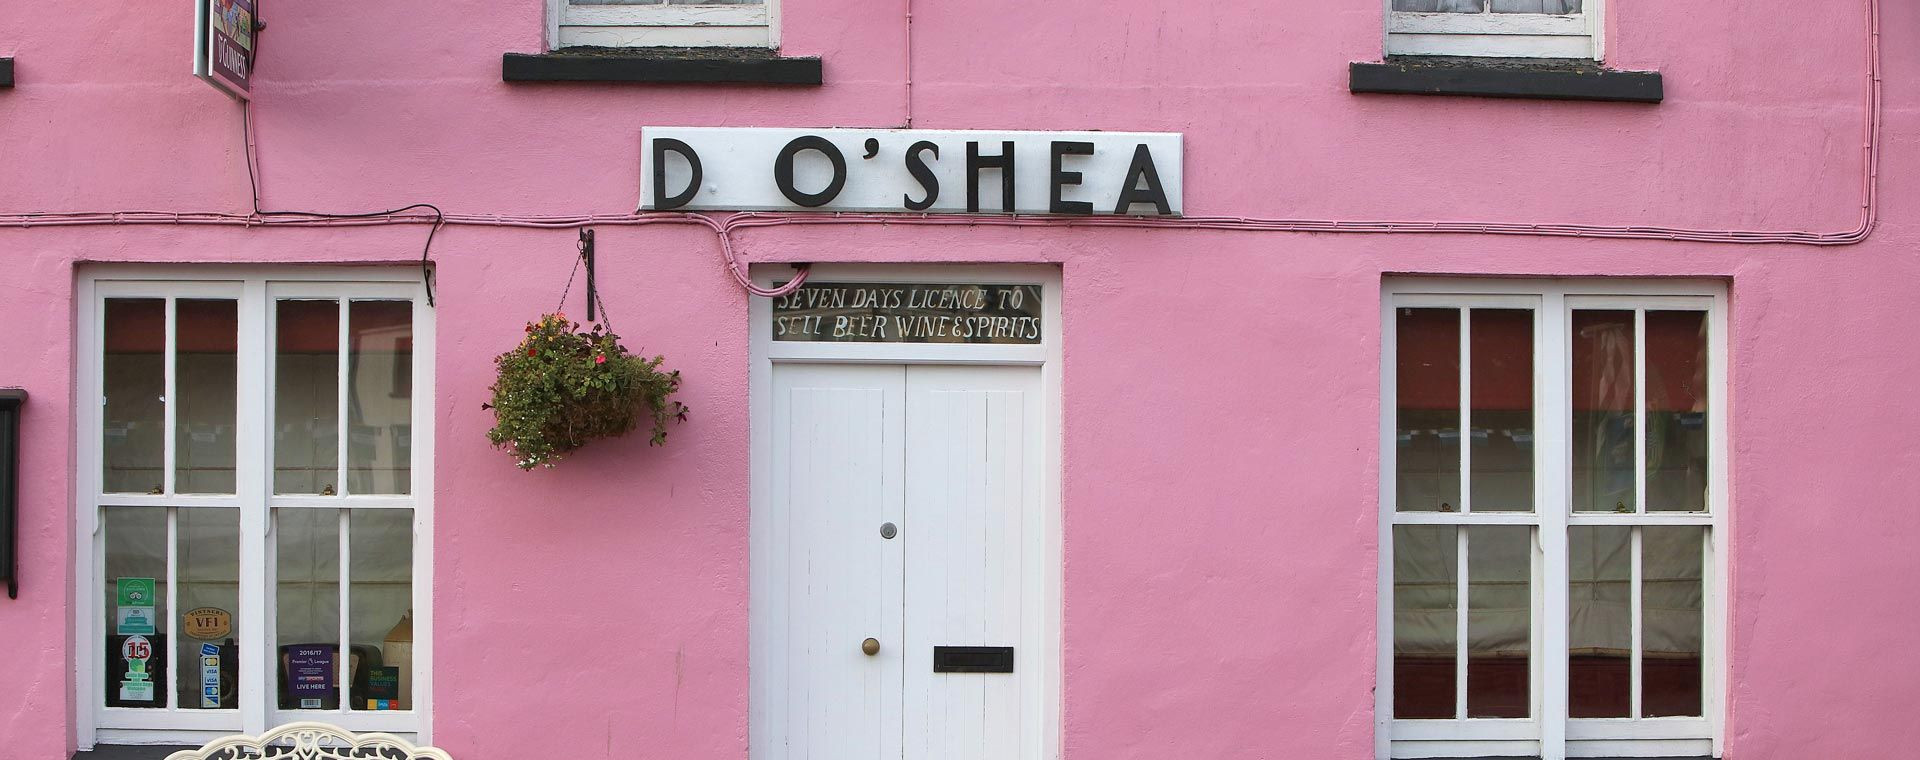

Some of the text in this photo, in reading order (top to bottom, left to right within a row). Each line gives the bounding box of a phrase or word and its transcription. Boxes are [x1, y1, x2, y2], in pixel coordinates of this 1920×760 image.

[222, 38, 246, 80] GUINNESS
[652, 137, 703, 210] D
[778, 288, 1024, 310] SEVEN DAYS LICENCE TO
[778, 315, 823, 336] SELL
[833, 315, 888, 338] BEER
[895, 315, 950, 338] WINE
[195, 617, 218, 628] VFI
